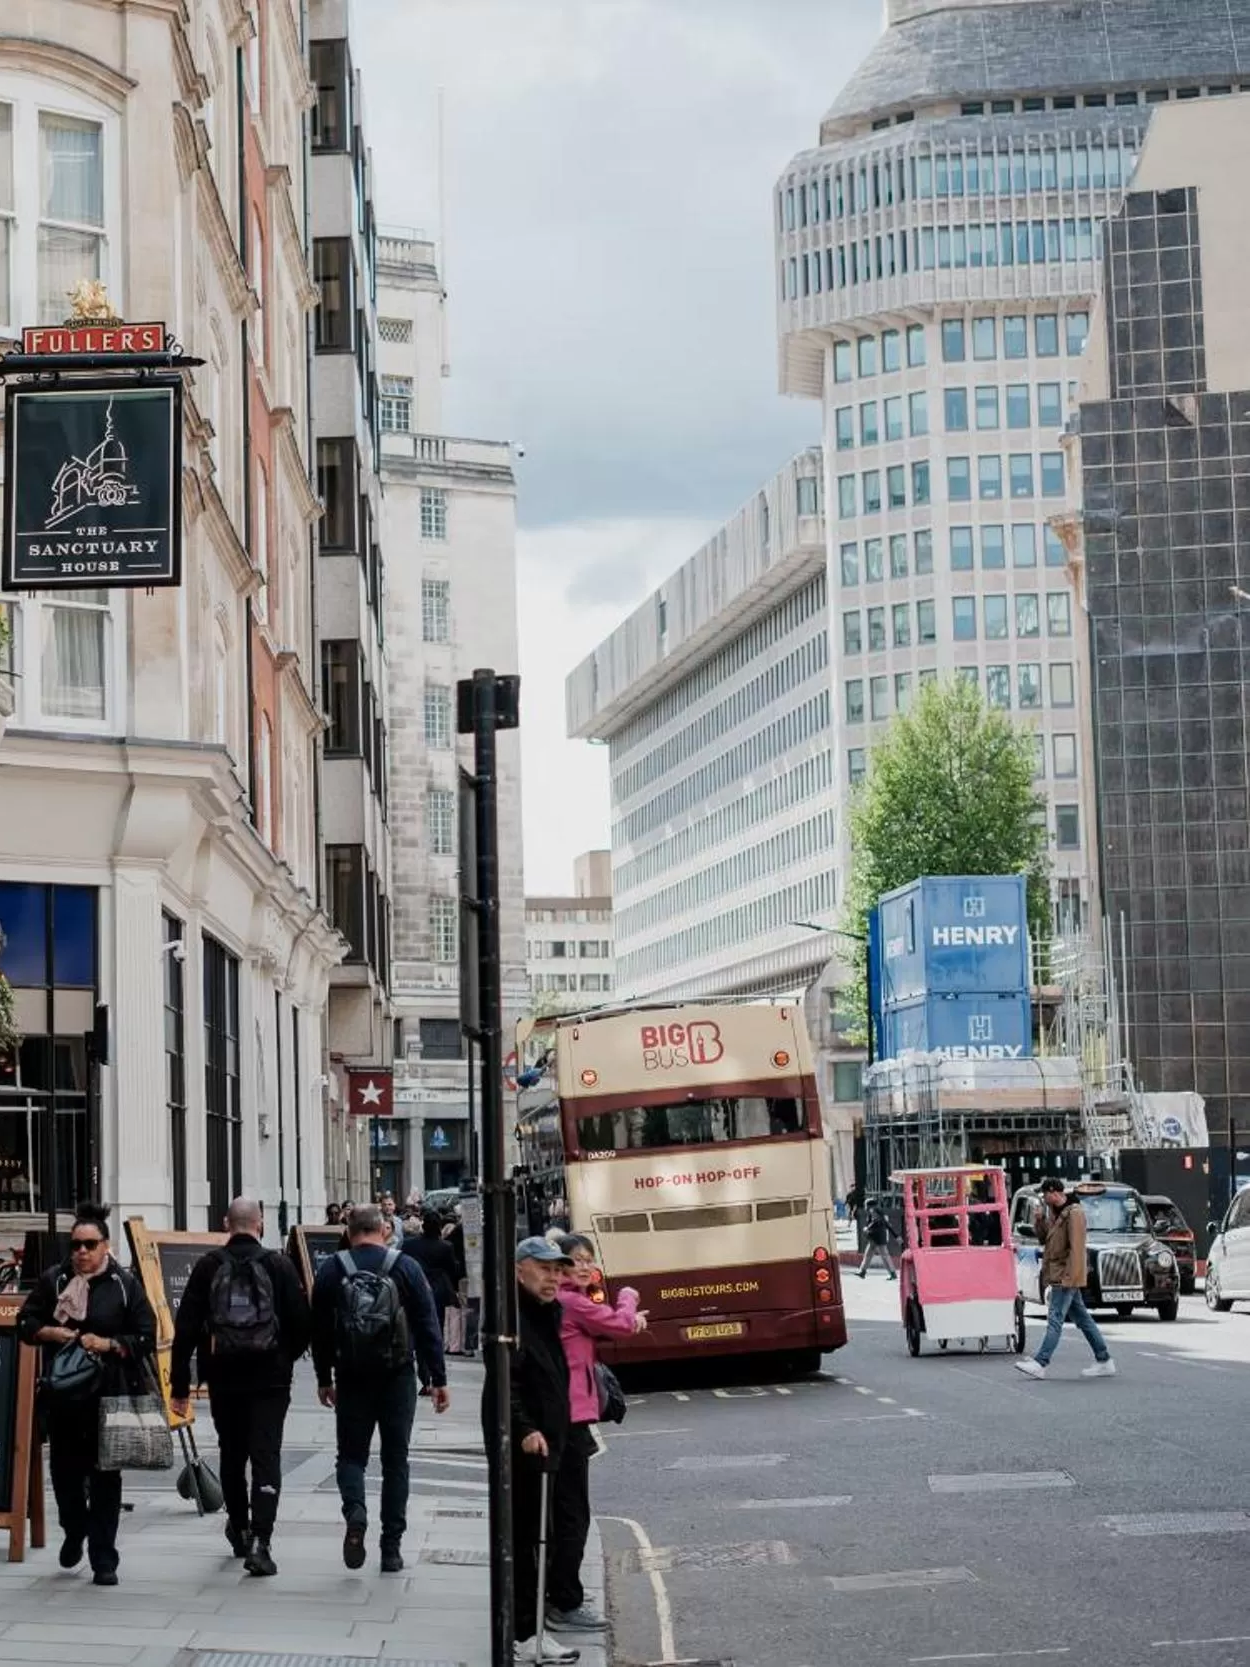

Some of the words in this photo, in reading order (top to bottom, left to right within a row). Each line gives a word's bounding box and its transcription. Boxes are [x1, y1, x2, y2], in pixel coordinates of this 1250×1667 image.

[32, 328, 155, 352] FULLER'S
[75, 526, 108, 537] THE
[29, 540, 158, 557] SANCTUARY
[61, 561, 120, 573] HOUSE
[932, 925, 1019, 946] HENRY
[641, 1023, 685, 1049] BIG
[643, 1048, 689, 1071] BUS
[634, 1174, 693, 1189] HOP-ON
[696, 1166, 761, 1183] HOP-OFF
[660, 1281, 759, 1299] BIGBUSTOURS.COM
